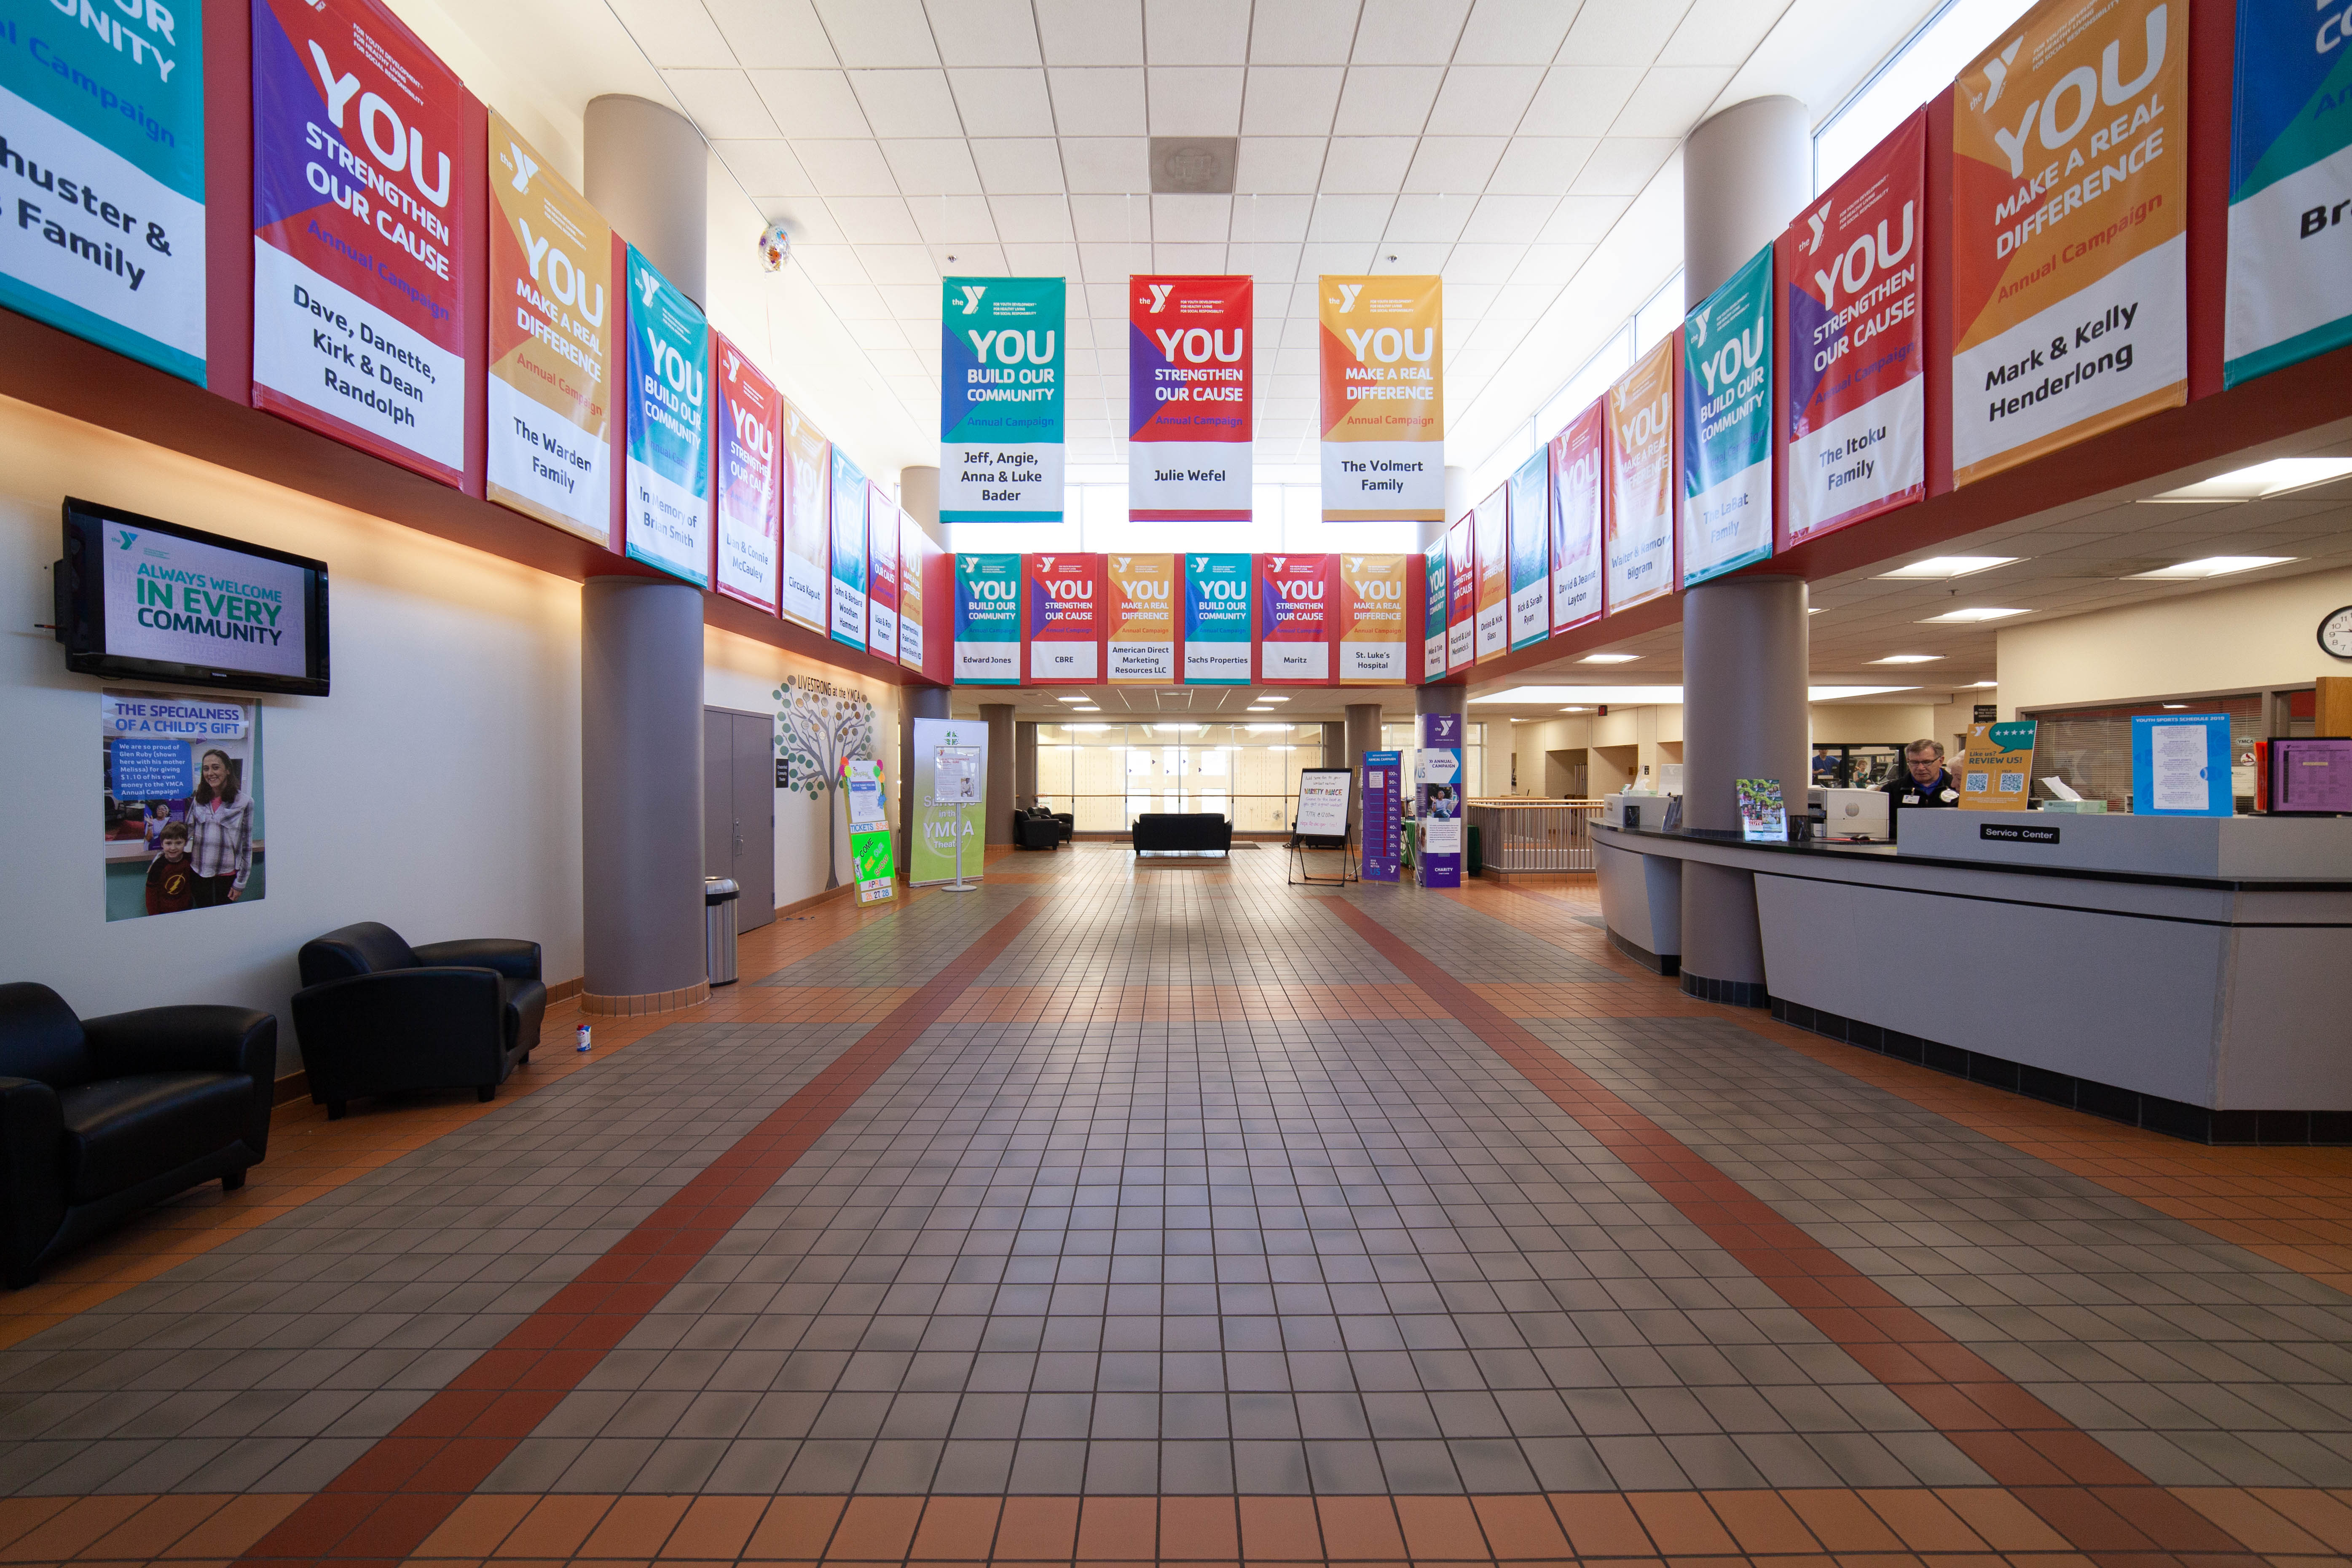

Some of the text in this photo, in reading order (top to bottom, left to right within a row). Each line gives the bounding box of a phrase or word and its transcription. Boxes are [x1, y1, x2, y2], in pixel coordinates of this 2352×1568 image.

[354, 40, 423, 106] FOR SOCIAL RESPONSIBILITY
[308, 39, 450, 207] YOU
[306, 122, 448, 246] STRENGTHEN
[306, 161, 448, 281] OUR CAUSE
[18, 198, 145, 291] Family
[294, 284, 435, 384] Dave, Danette,
[1985, 302, 2138, 391] Mark & Kelly
[314, 329, 423, 402] Kirk & Dean
[1990, 343, 2133, 422] Henderlong
[325, 368, 414, 427] Randolph
[513, 416, 591, 473] The Warden
[1819, 426, 1886, 468] The Itoku
[964, 452, 1038, 466] Jeff, Angie,
[1341, 460, 1423, 472] The Volmert
[533, 456, 574, 494] Family
[961, 471, 1042, 482] Anna & Luke
[1154, 470, 1225, 481] Julie Wefel
[1362, 479, 1403, 493] Family
[1828, 459, 1875, 490] Family
[640, 486, 649, 503] In
[687, 516, 697, 528] of
[982, 490, 1021, 501] Bader
[1703, 509, 1719, 525] The
[644, 512, 693, 547] Brian Smith
[1711, 521, 1739, 543] Family
[741, 541, 746, 553] &
[748, 545, 768, 565] Connie
[733, 556, 762, 583] McCauley
[1628, 561, 1652, 579] Bilgram
[137, 563, 282, 603] ALWAYS WELCOME
[789, 576, 820, 600] Circus Kaput
[969, 581, 1016, 600] YOU
[1559, 570, 1596, 594] David & Jeanne
[137, 578, 282, 627] IN EVERY
[997, 602, 1016, 610] OUR
[1526, 600, 1529, 608] &
[1530, 594, 1542, 608] Sarah
[1568, 592, 1586, 606] Layton
[138, 608, 282, 646] COMMUNITY
[1524, 614, 1534, 625] Ryan
[1210, 657, 1247, 665] Properties
[798, 675, 831, 696] LIVESTRONG
[833, 687, 837, 697] at
[847, 688, 860, 703] YMCA
[115, 703, 239, 720] THE SPECIALNESS
[115, 718, 239, 734] OF A CHILD'S GIFT
[850, 823, 873, 833] TICKETS
[859, 837, 874, 857] COME
[865, 842, 884, 871] SEE OUR
[875, 854, 889, 876] SHOW!
[868, 879, 883, 889] APRIL
[882, 889, 889, 897] 28
